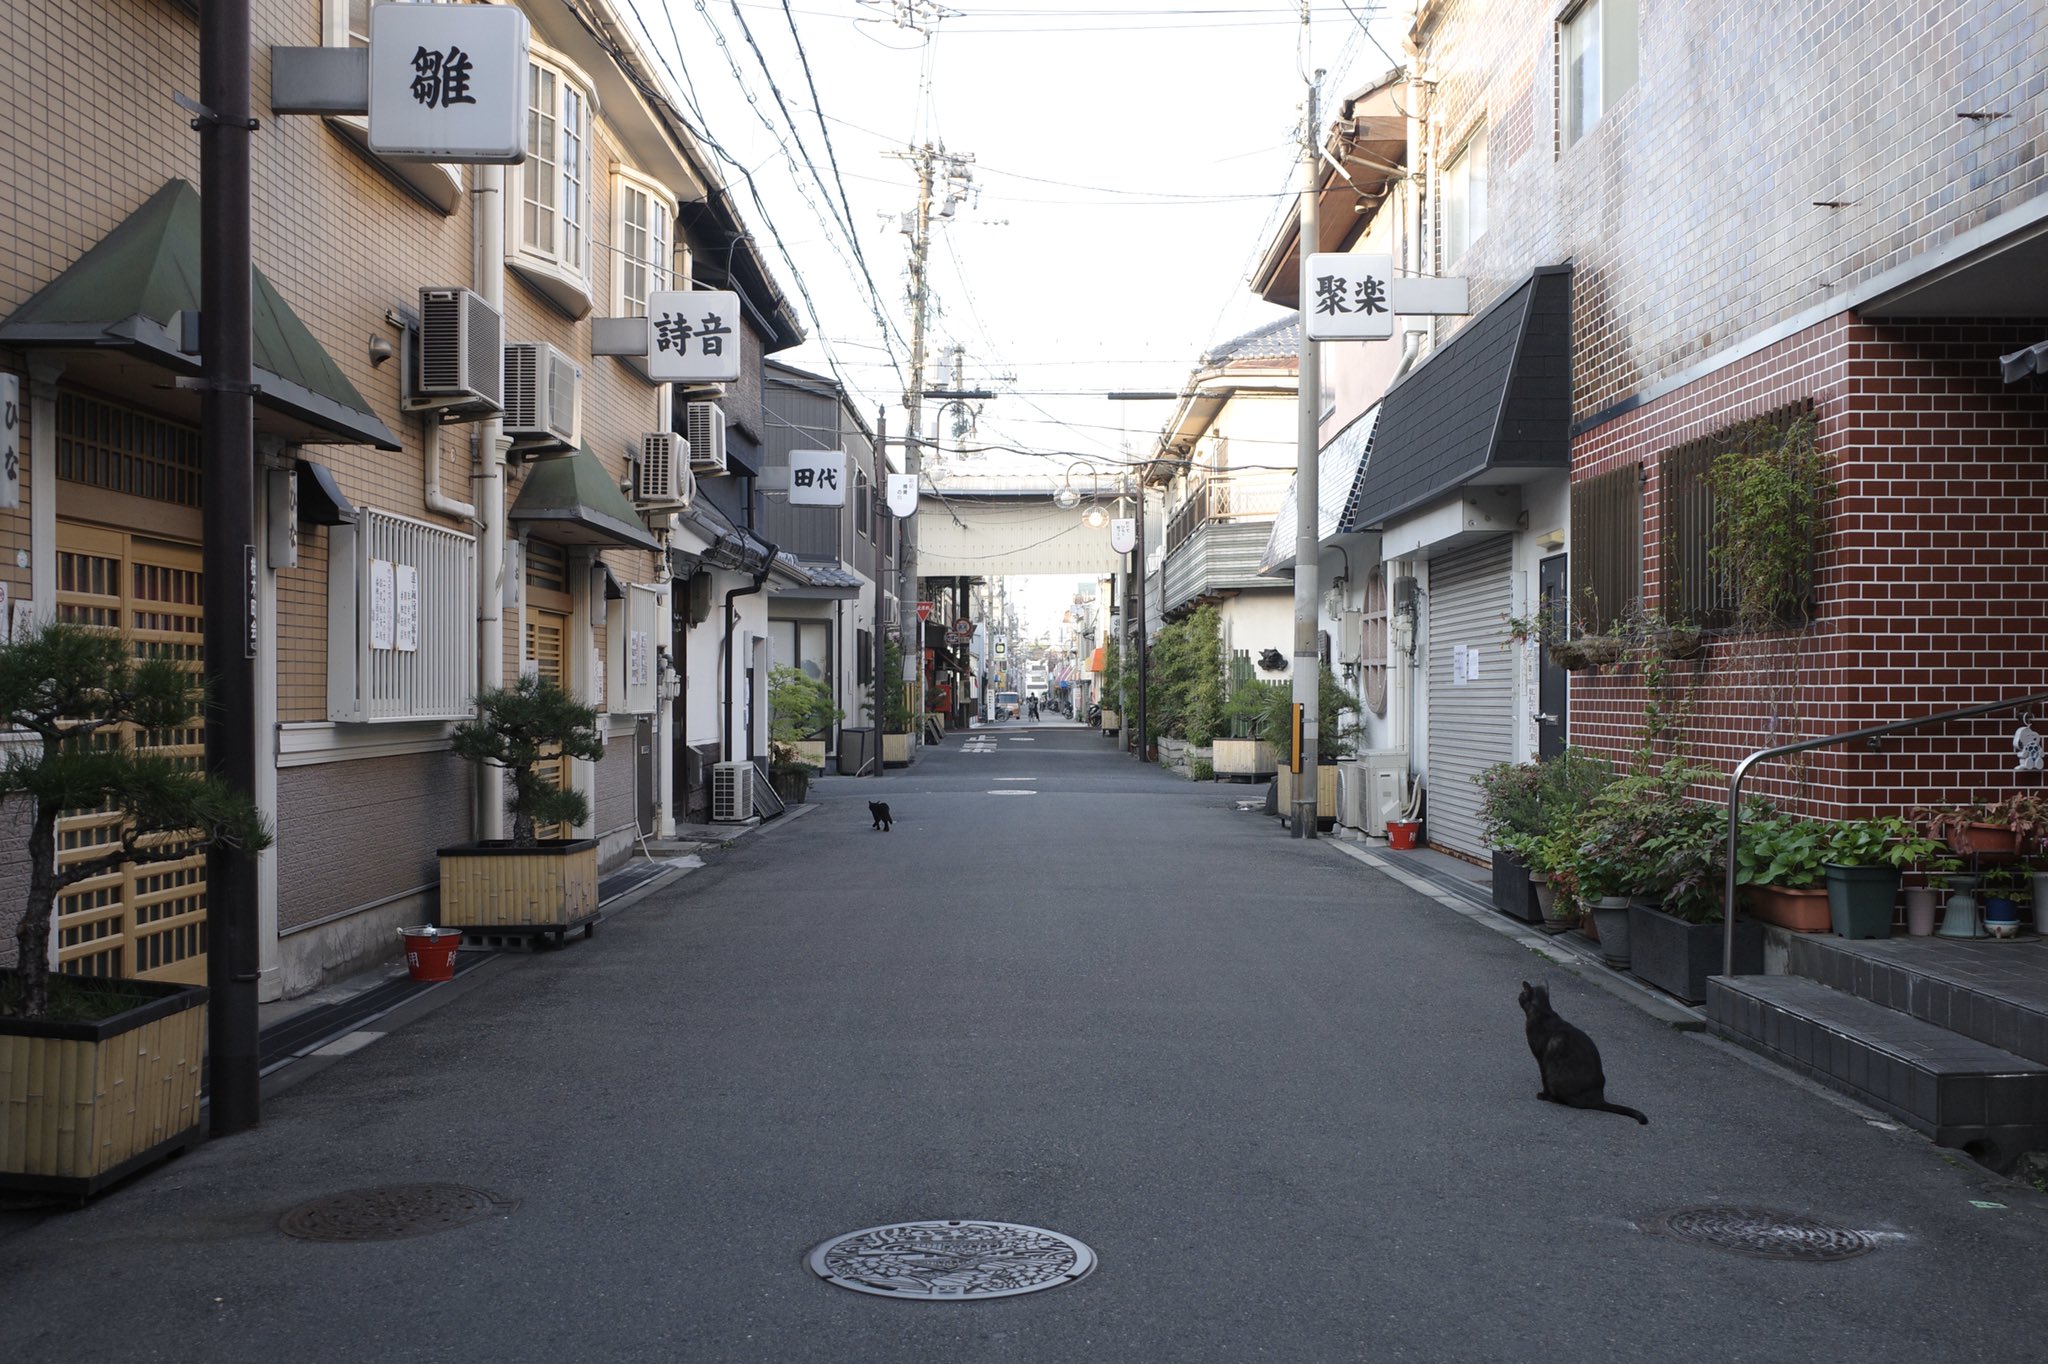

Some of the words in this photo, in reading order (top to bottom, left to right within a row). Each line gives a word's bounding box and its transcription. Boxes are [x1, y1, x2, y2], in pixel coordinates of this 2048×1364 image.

[410, 45, 477, 109] 雛
[1315, 274, 1389, 316] 聚楽
[654, 312, 732, 357] 詩音
[4, 401, 19, 480] ひな
[794, 467, 839, 491] 田代
